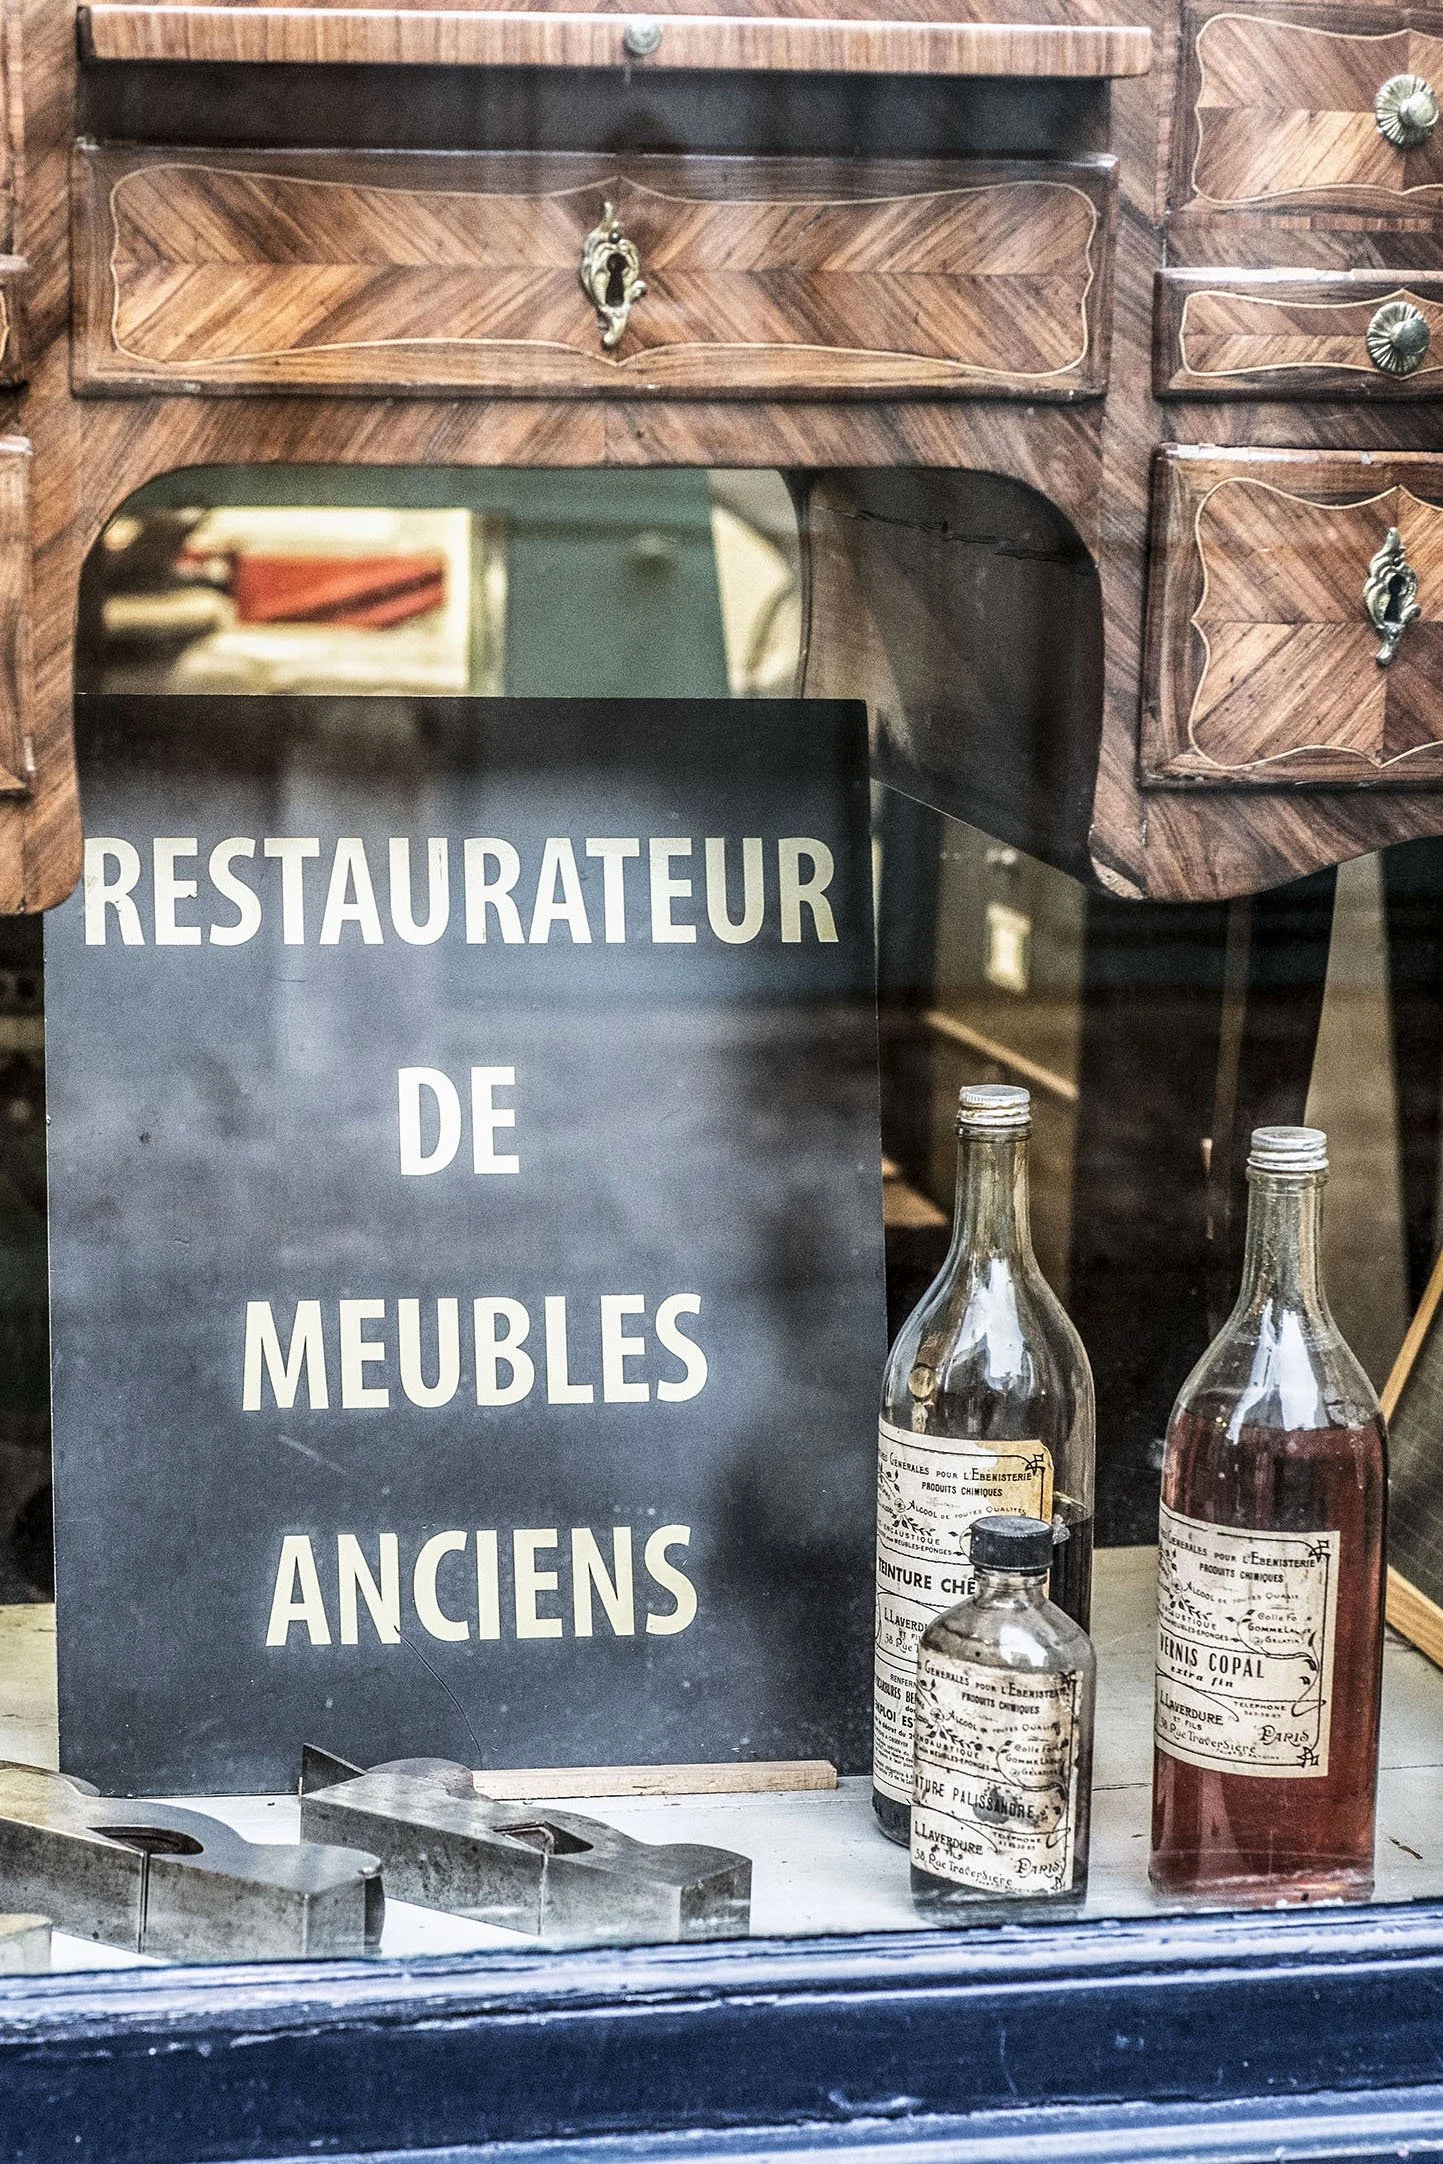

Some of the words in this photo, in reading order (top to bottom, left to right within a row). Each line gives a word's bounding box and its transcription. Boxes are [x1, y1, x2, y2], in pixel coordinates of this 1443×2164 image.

[83, 836, 840, 947] RESTAURATEUR
[398, 1065, 521, 1177] DE
[242, 1293, 709, 1412] MEUBLES
[936, 1470, 958, 1480] POUR
[921, 1481, 957, 1494] PRODUITS
[961, 1487, 1004, 1498] CHIMIQUES
[907, 1500, 937, 1519] ALCOOL
[1214, 1552, 1237, 1562] POUR
[878, 1556, 933, 1590] TEINTURE
[1200, 1563, 1236, 1578] PRODUITS
[1240, 1571, 1284, 1584] CHIMIQUES
[266, 1524, 699, 1648] ANCIENS
[1160, 1631, 1198, 1668] VERNIS
[1208, 1652, 1265, 1679] COPAL
[1170, 1665, 1204, 1682] extra
[1211, 1676, 1234, 1688] fin
[961, 1691, 996, 1707] PRODUITS
[999, 1700, 1041, 1715] CHIMIQUES
[1184, 1719, 1203, 1731] FILS
[952, 1786, 1034, 1820] PALISSANDRE
